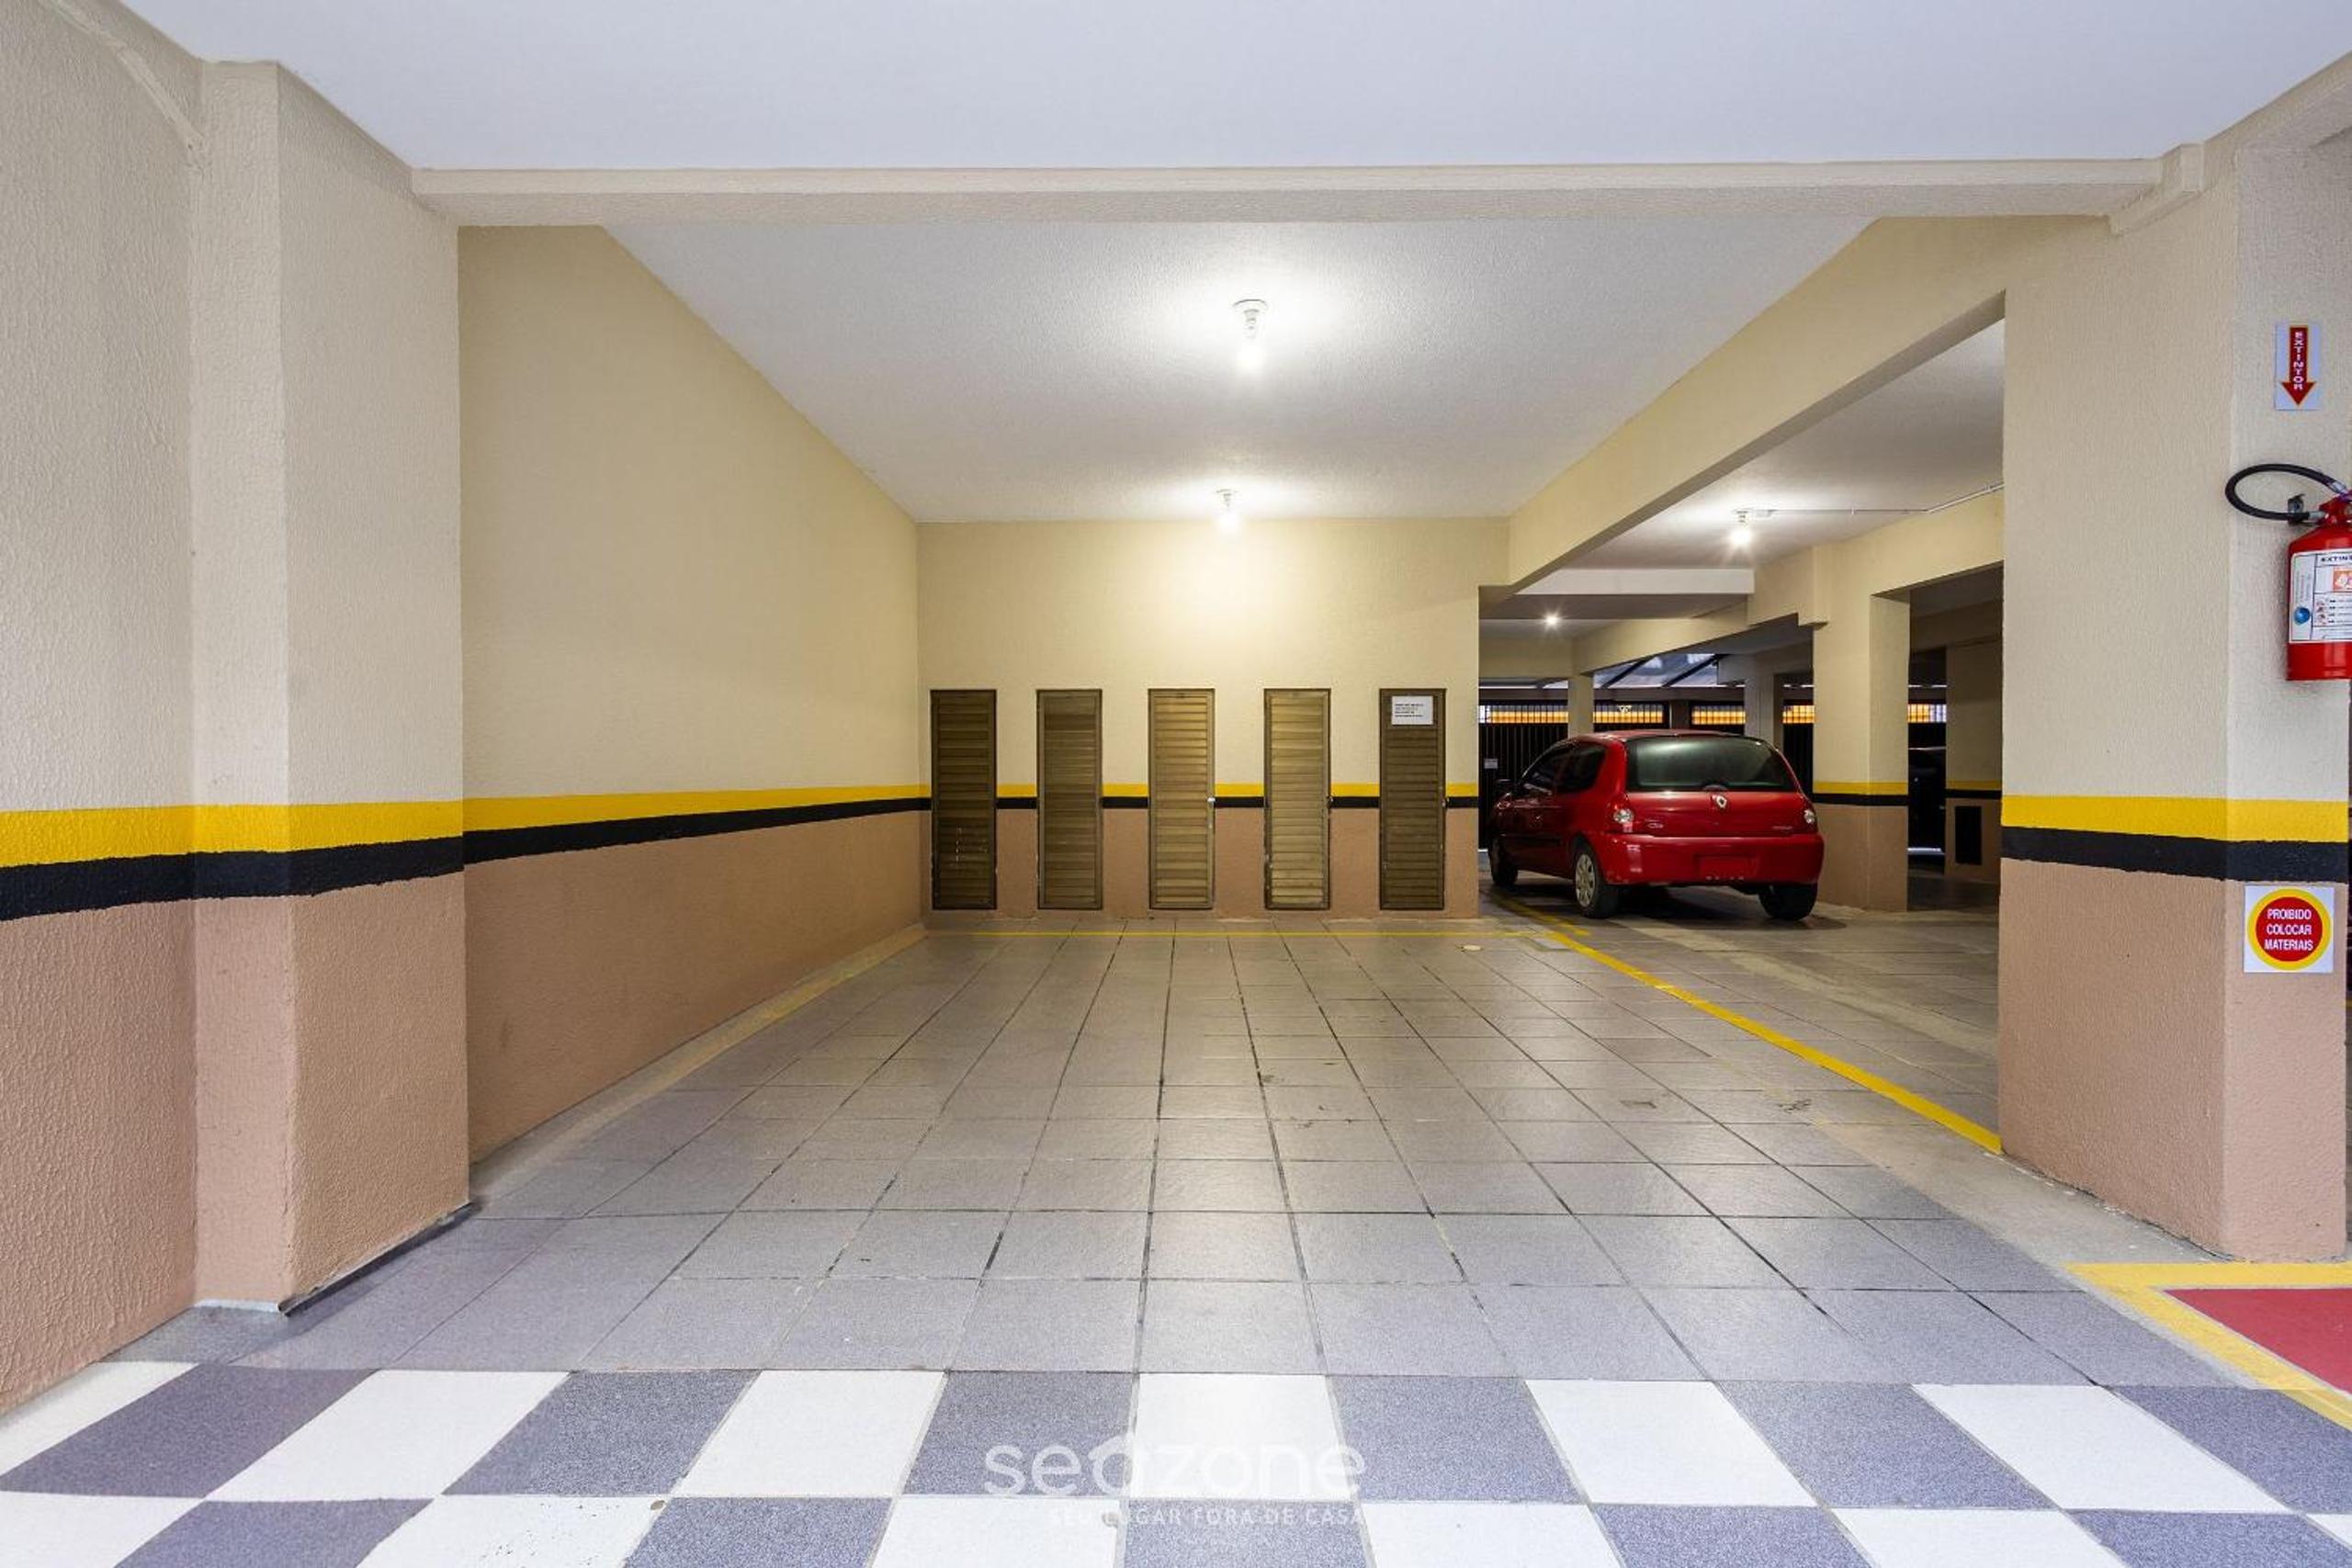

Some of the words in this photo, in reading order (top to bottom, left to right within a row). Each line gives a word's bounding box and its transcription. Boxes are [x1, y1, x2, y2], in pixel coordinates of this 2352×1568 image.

[2292, 331, 2304, 389] EXTINTOR
[2267, 908, 2312, 919] PROIBIDO
[2267, 924, 2312, 935] COLOCAR
[2264, 939, 2313, 951] MATERIAIS
